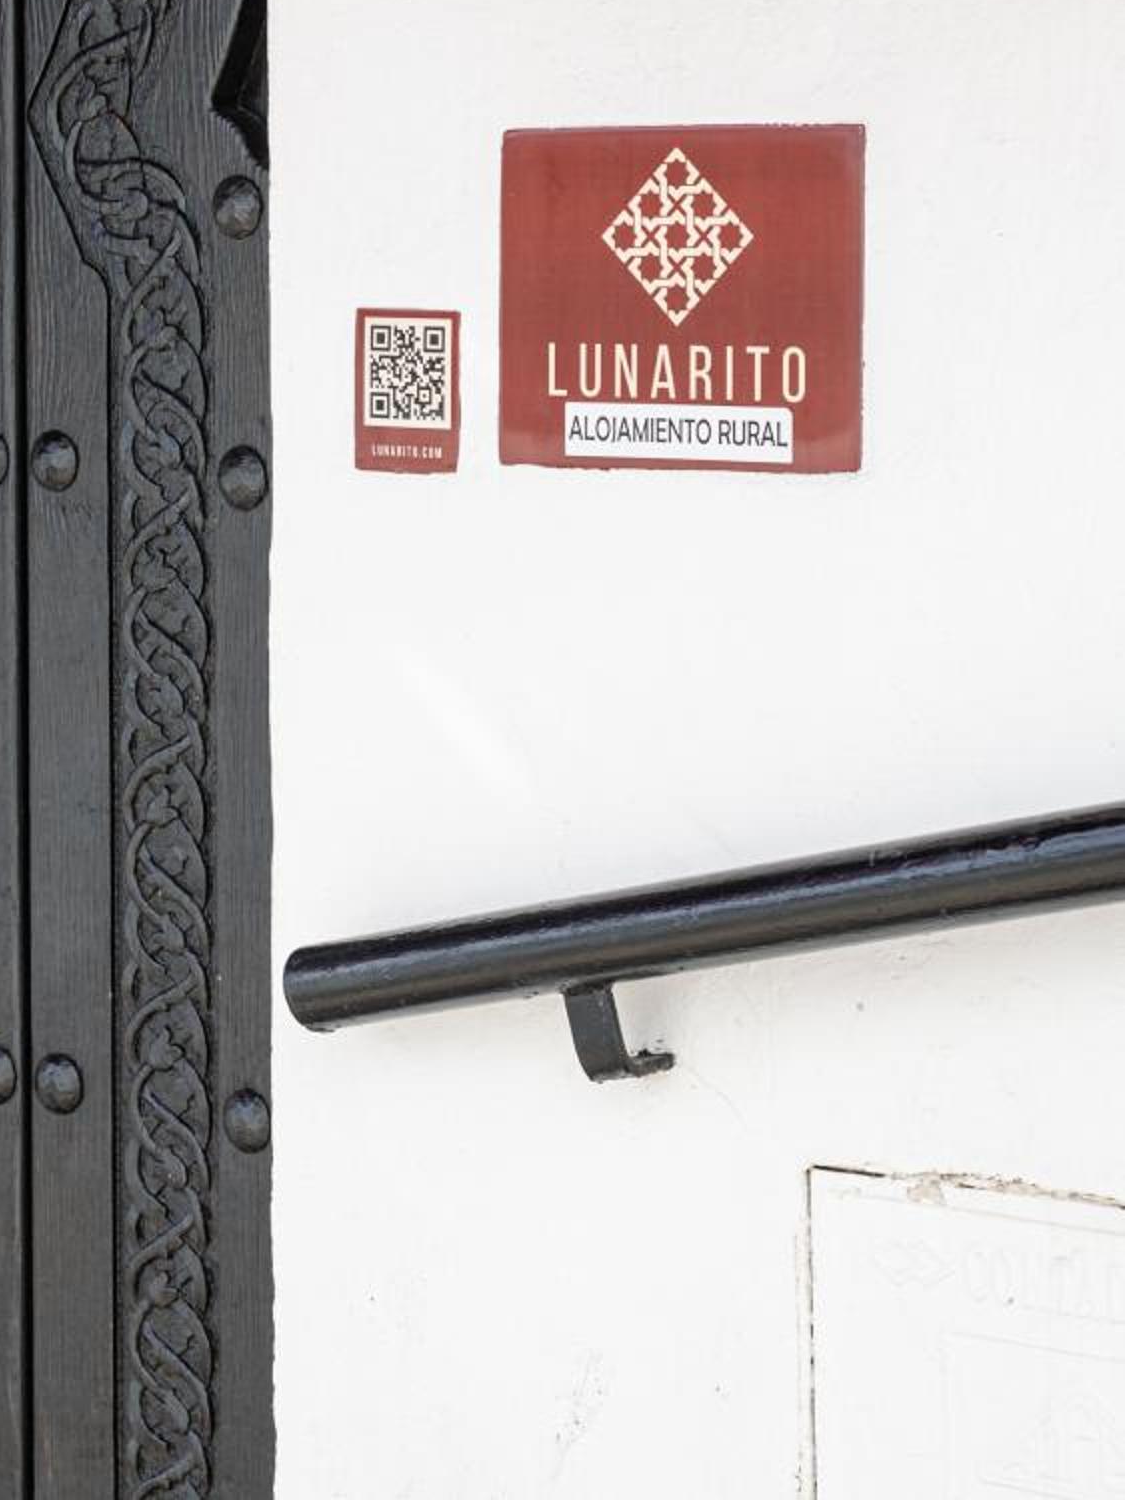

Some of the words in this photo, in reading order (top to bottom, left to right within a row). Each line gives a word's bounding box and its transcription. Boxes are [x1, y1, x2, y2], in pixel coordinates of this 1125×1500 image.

[548, 342, 807, 404] LUNARITO
[569, 415, 712, 445] ALOJAMIENTO
[718, 419, 788, 448] RURAL
[371, 443, 443, 460] LUNARITO.COM
